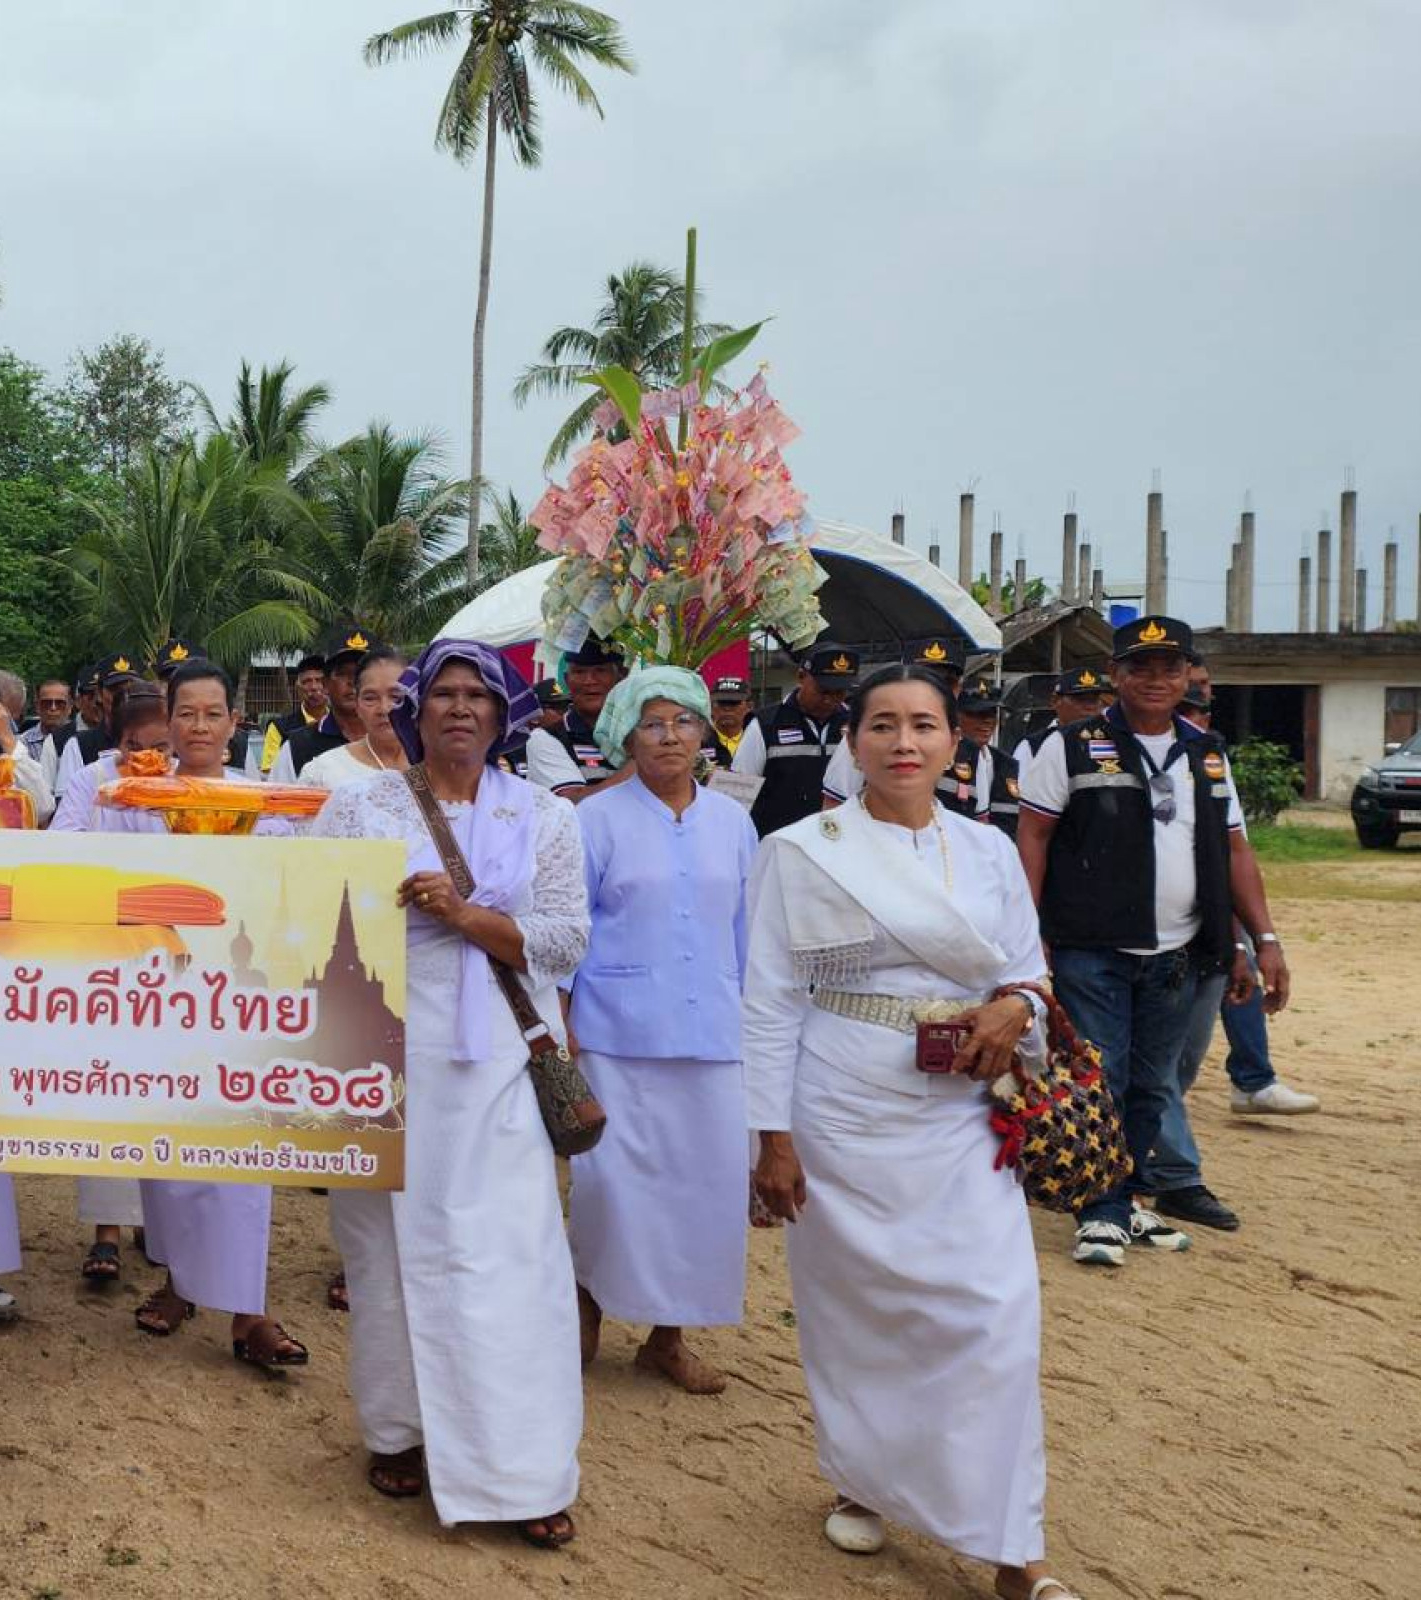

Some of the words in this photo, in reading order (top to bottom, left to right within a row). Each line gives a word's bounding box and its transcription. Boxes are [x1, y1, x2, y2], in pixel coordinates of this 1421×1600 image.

[9, 1058, 201, 1106] พุทธศักราช
[217, 1064, 386, 1109] ๒๕๖๘
[153, 1137, 171, 1162] ปี
